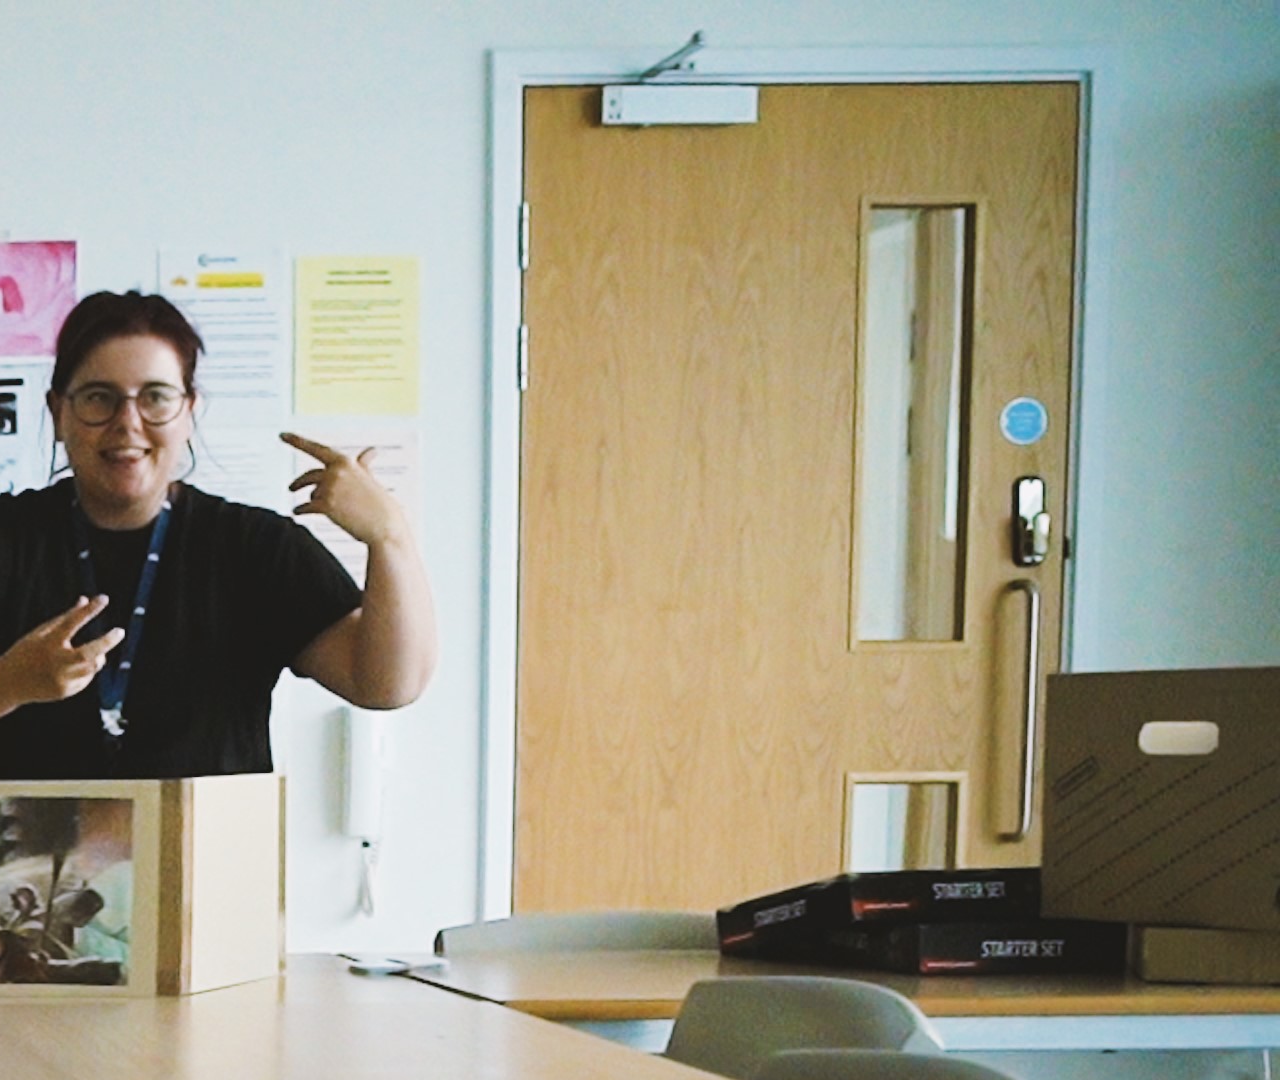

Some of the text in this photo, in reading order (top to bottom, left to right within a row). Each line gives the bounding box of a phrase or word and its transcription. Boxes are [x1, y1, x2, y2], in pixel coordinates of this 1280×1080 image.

[931, 881, 1006, 899] STARTER SET
[981, 939, 1065, 958] STARTER SET
